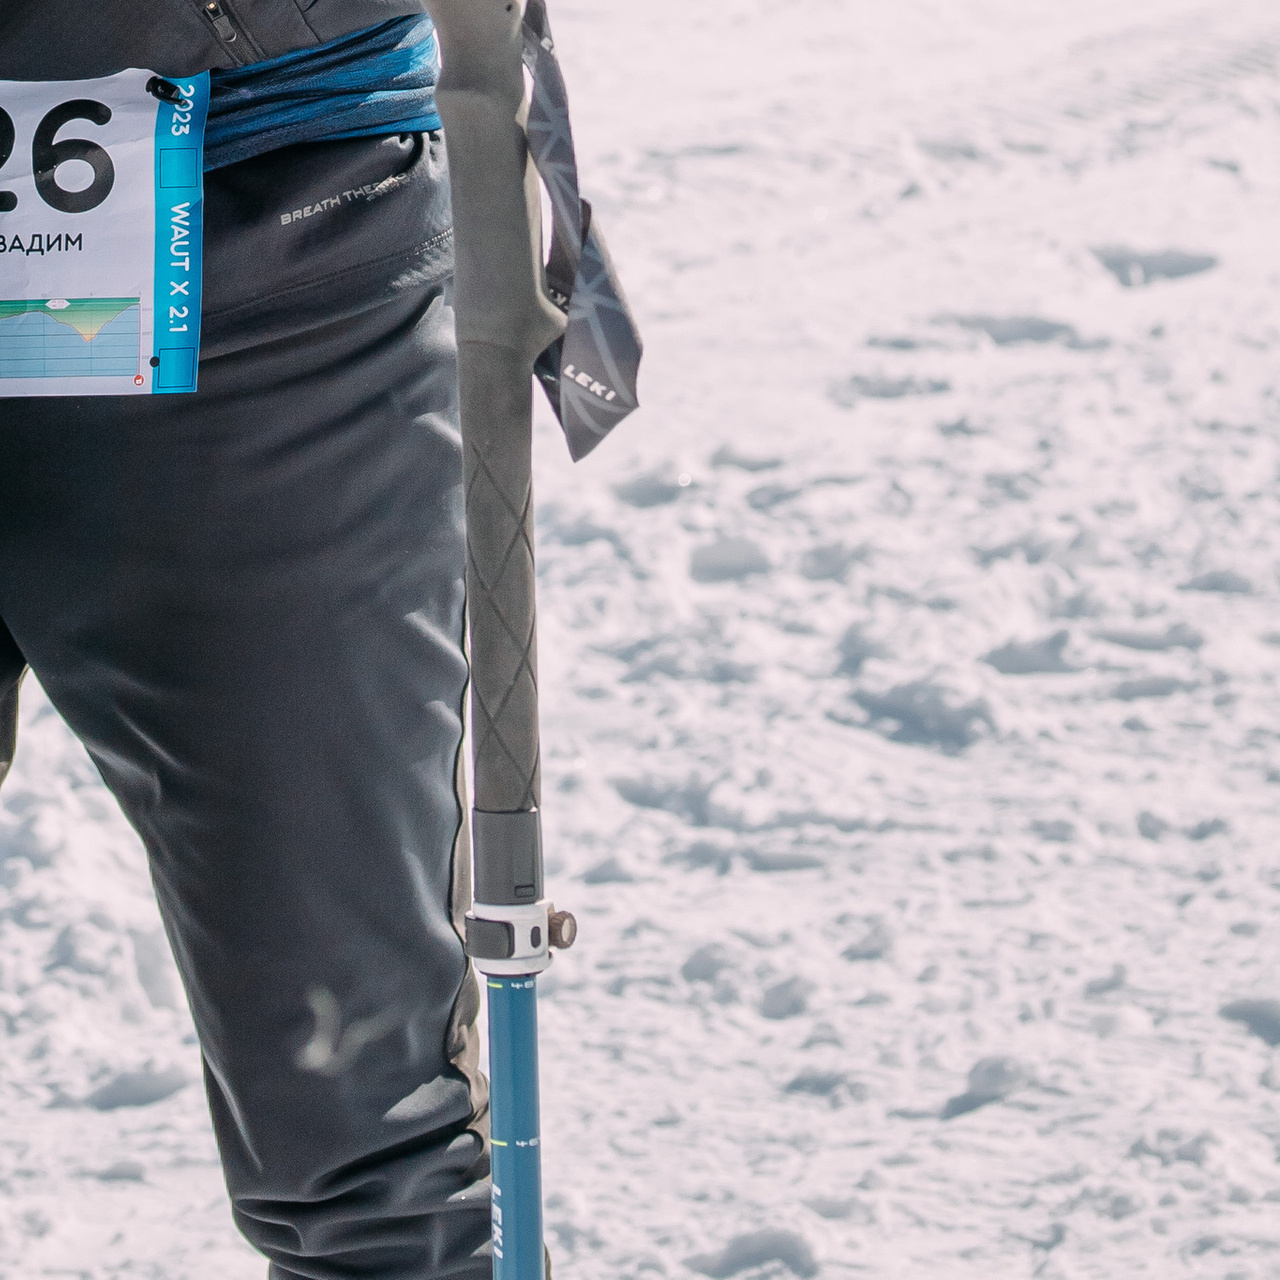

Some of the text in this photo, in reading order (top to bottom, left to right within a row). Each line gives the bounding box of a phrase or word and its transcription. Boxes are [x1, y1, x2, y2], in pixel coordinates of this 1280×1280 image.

[171, 84, 195, 137] 2023
[280, 194, 341, 226] BREATH
[168, 201, 191, 333] WAUT X 2.1
[563, 364, 616, 401] LEKI
[491, 1183, 504, 1260] LEKI
